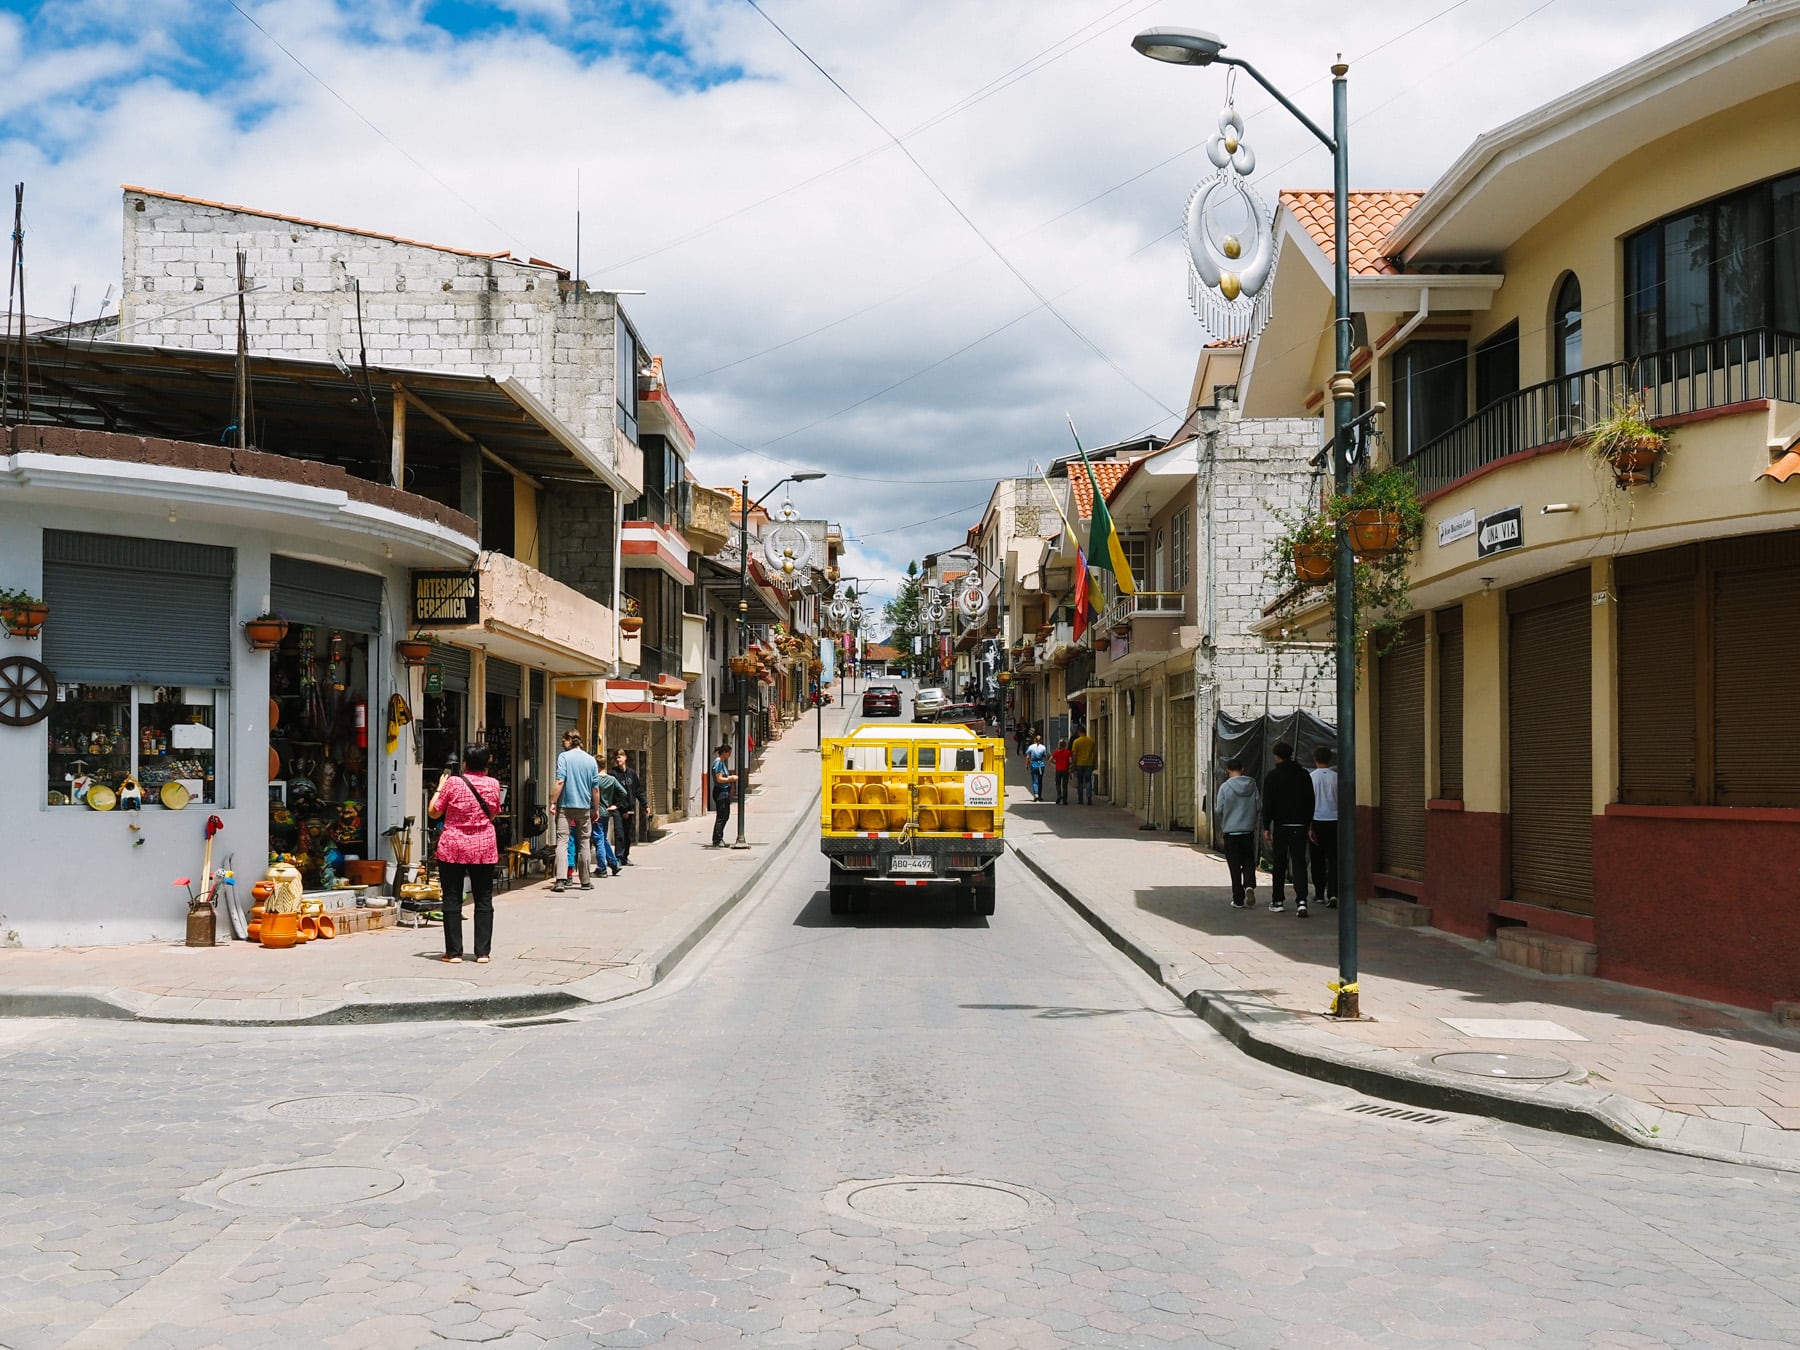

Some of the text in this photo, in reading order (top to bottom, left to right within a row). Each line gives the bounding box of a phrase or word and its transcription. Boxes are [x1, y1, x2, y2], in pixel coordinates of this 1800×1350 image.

[1487, 526, 1499, 542] UNA
[1502, 521, 1516, 538] VIA
[417, 577, 475, 598] ARTESANIAS
[417, 598, 467, 619] CERAMICA
